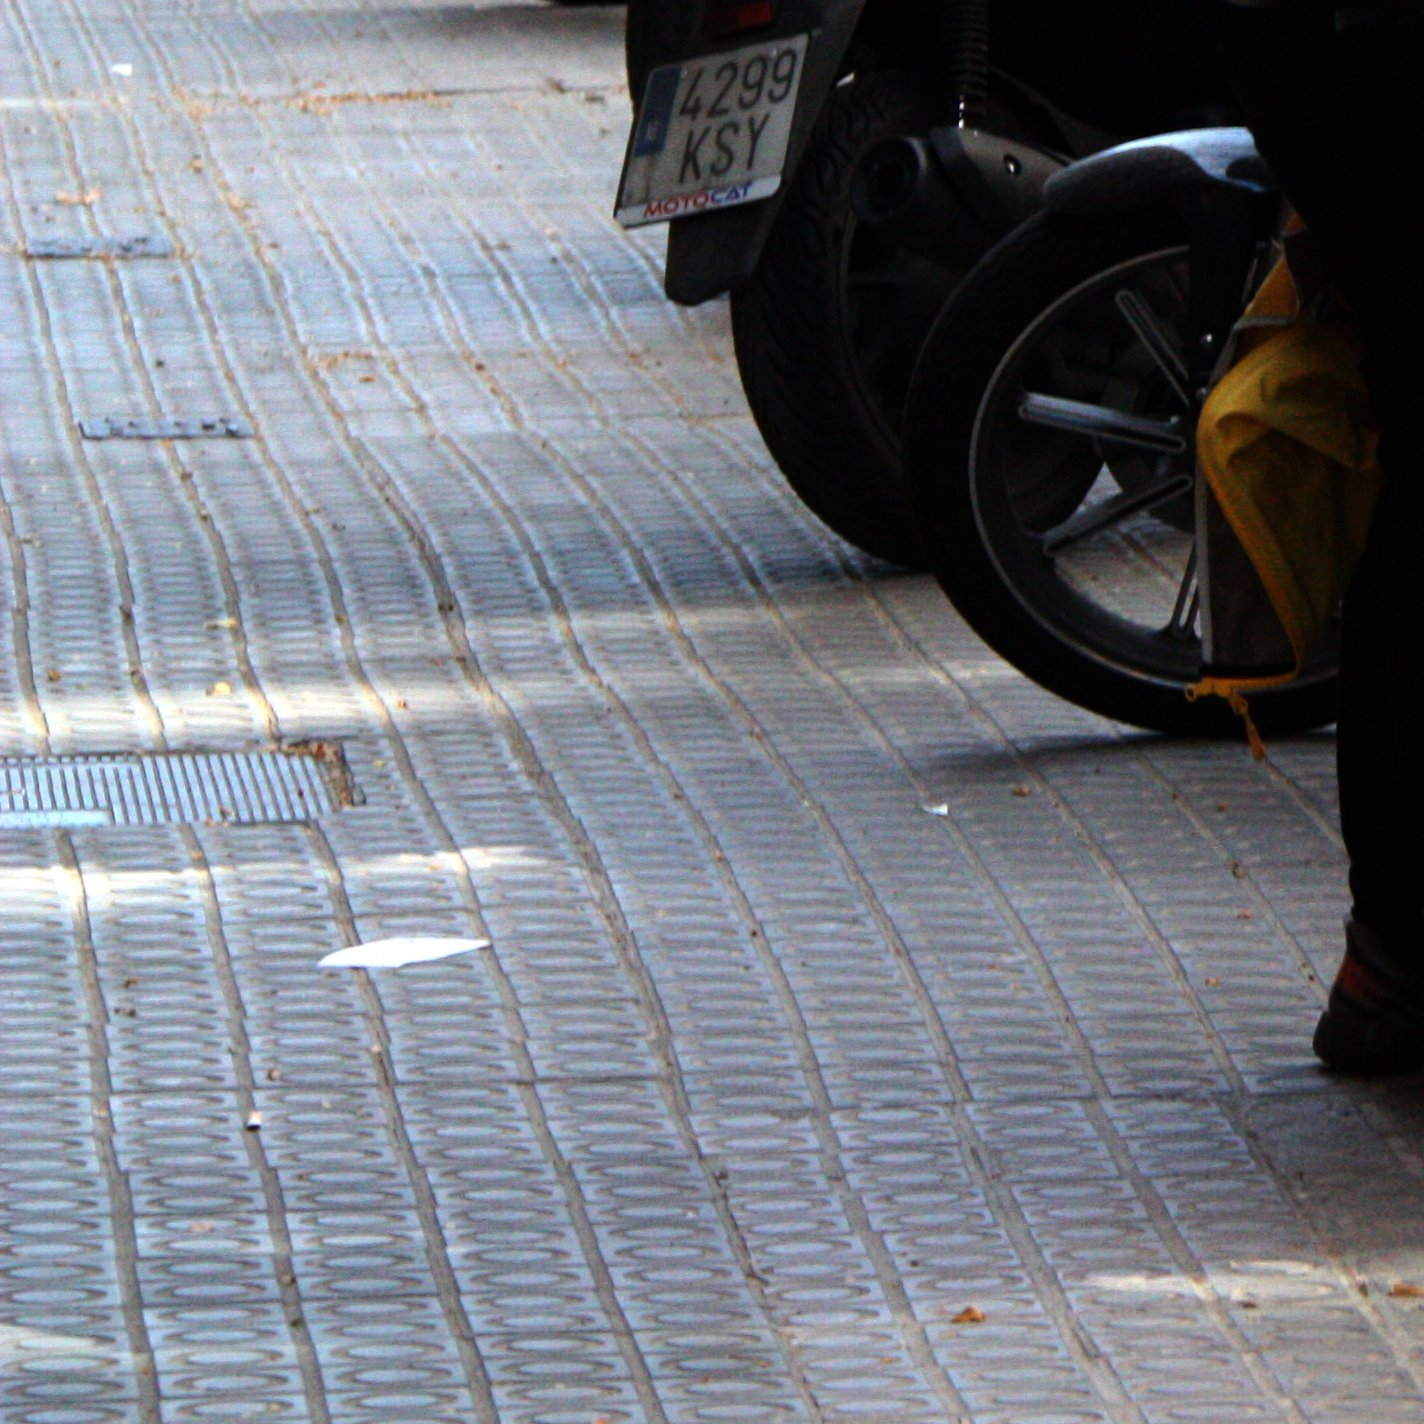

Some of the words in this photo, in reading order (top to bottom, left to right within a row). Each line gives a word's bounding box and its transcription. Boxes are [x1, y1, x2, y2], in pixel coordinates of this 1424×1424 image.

[678, 48, 798, 123] 4299
[678, 113, 771, 184] KSY
[643, 181, 754, 218] MOTOCAT
